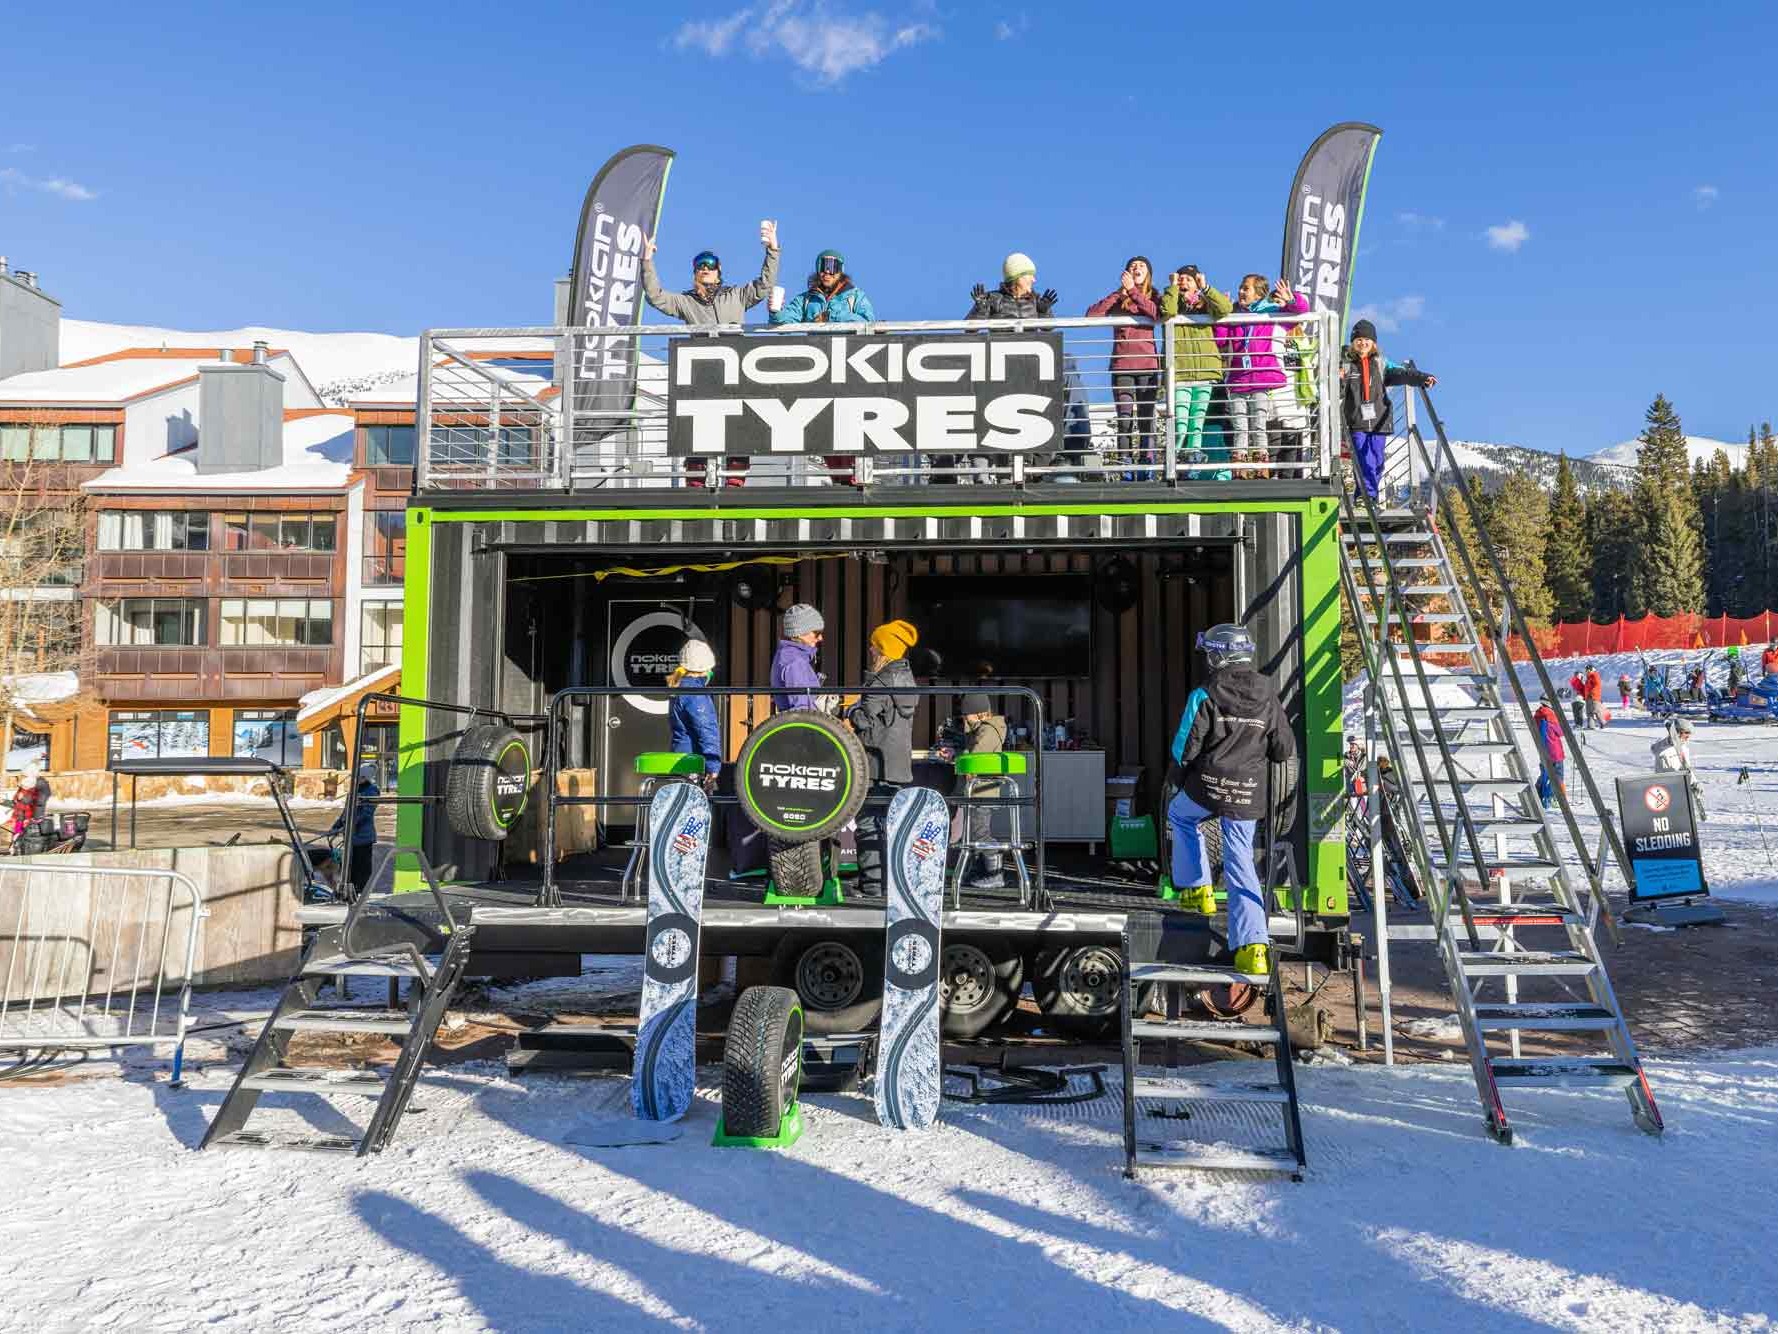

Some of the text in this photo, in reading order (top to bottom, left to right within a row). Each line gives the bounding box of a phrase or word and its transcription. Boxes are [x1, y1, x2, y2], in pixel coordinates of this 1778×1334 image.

[1296, 195, 1321, 293] kian
[1315, 202, 1345, 311] RES
[602, 222, 642, 380] TYRES
[676, 336, 1055, 386] nokian
[676, 393, 1055, 452] TYRES
[630, 654, 681, 663] nokia
[759, 774, 836, 792] TYRES
[760, 763, 837, 778] nokian
[1653, 816, 1670, 833] NO
[1635, 832, 1691, 853] SLEDDING
